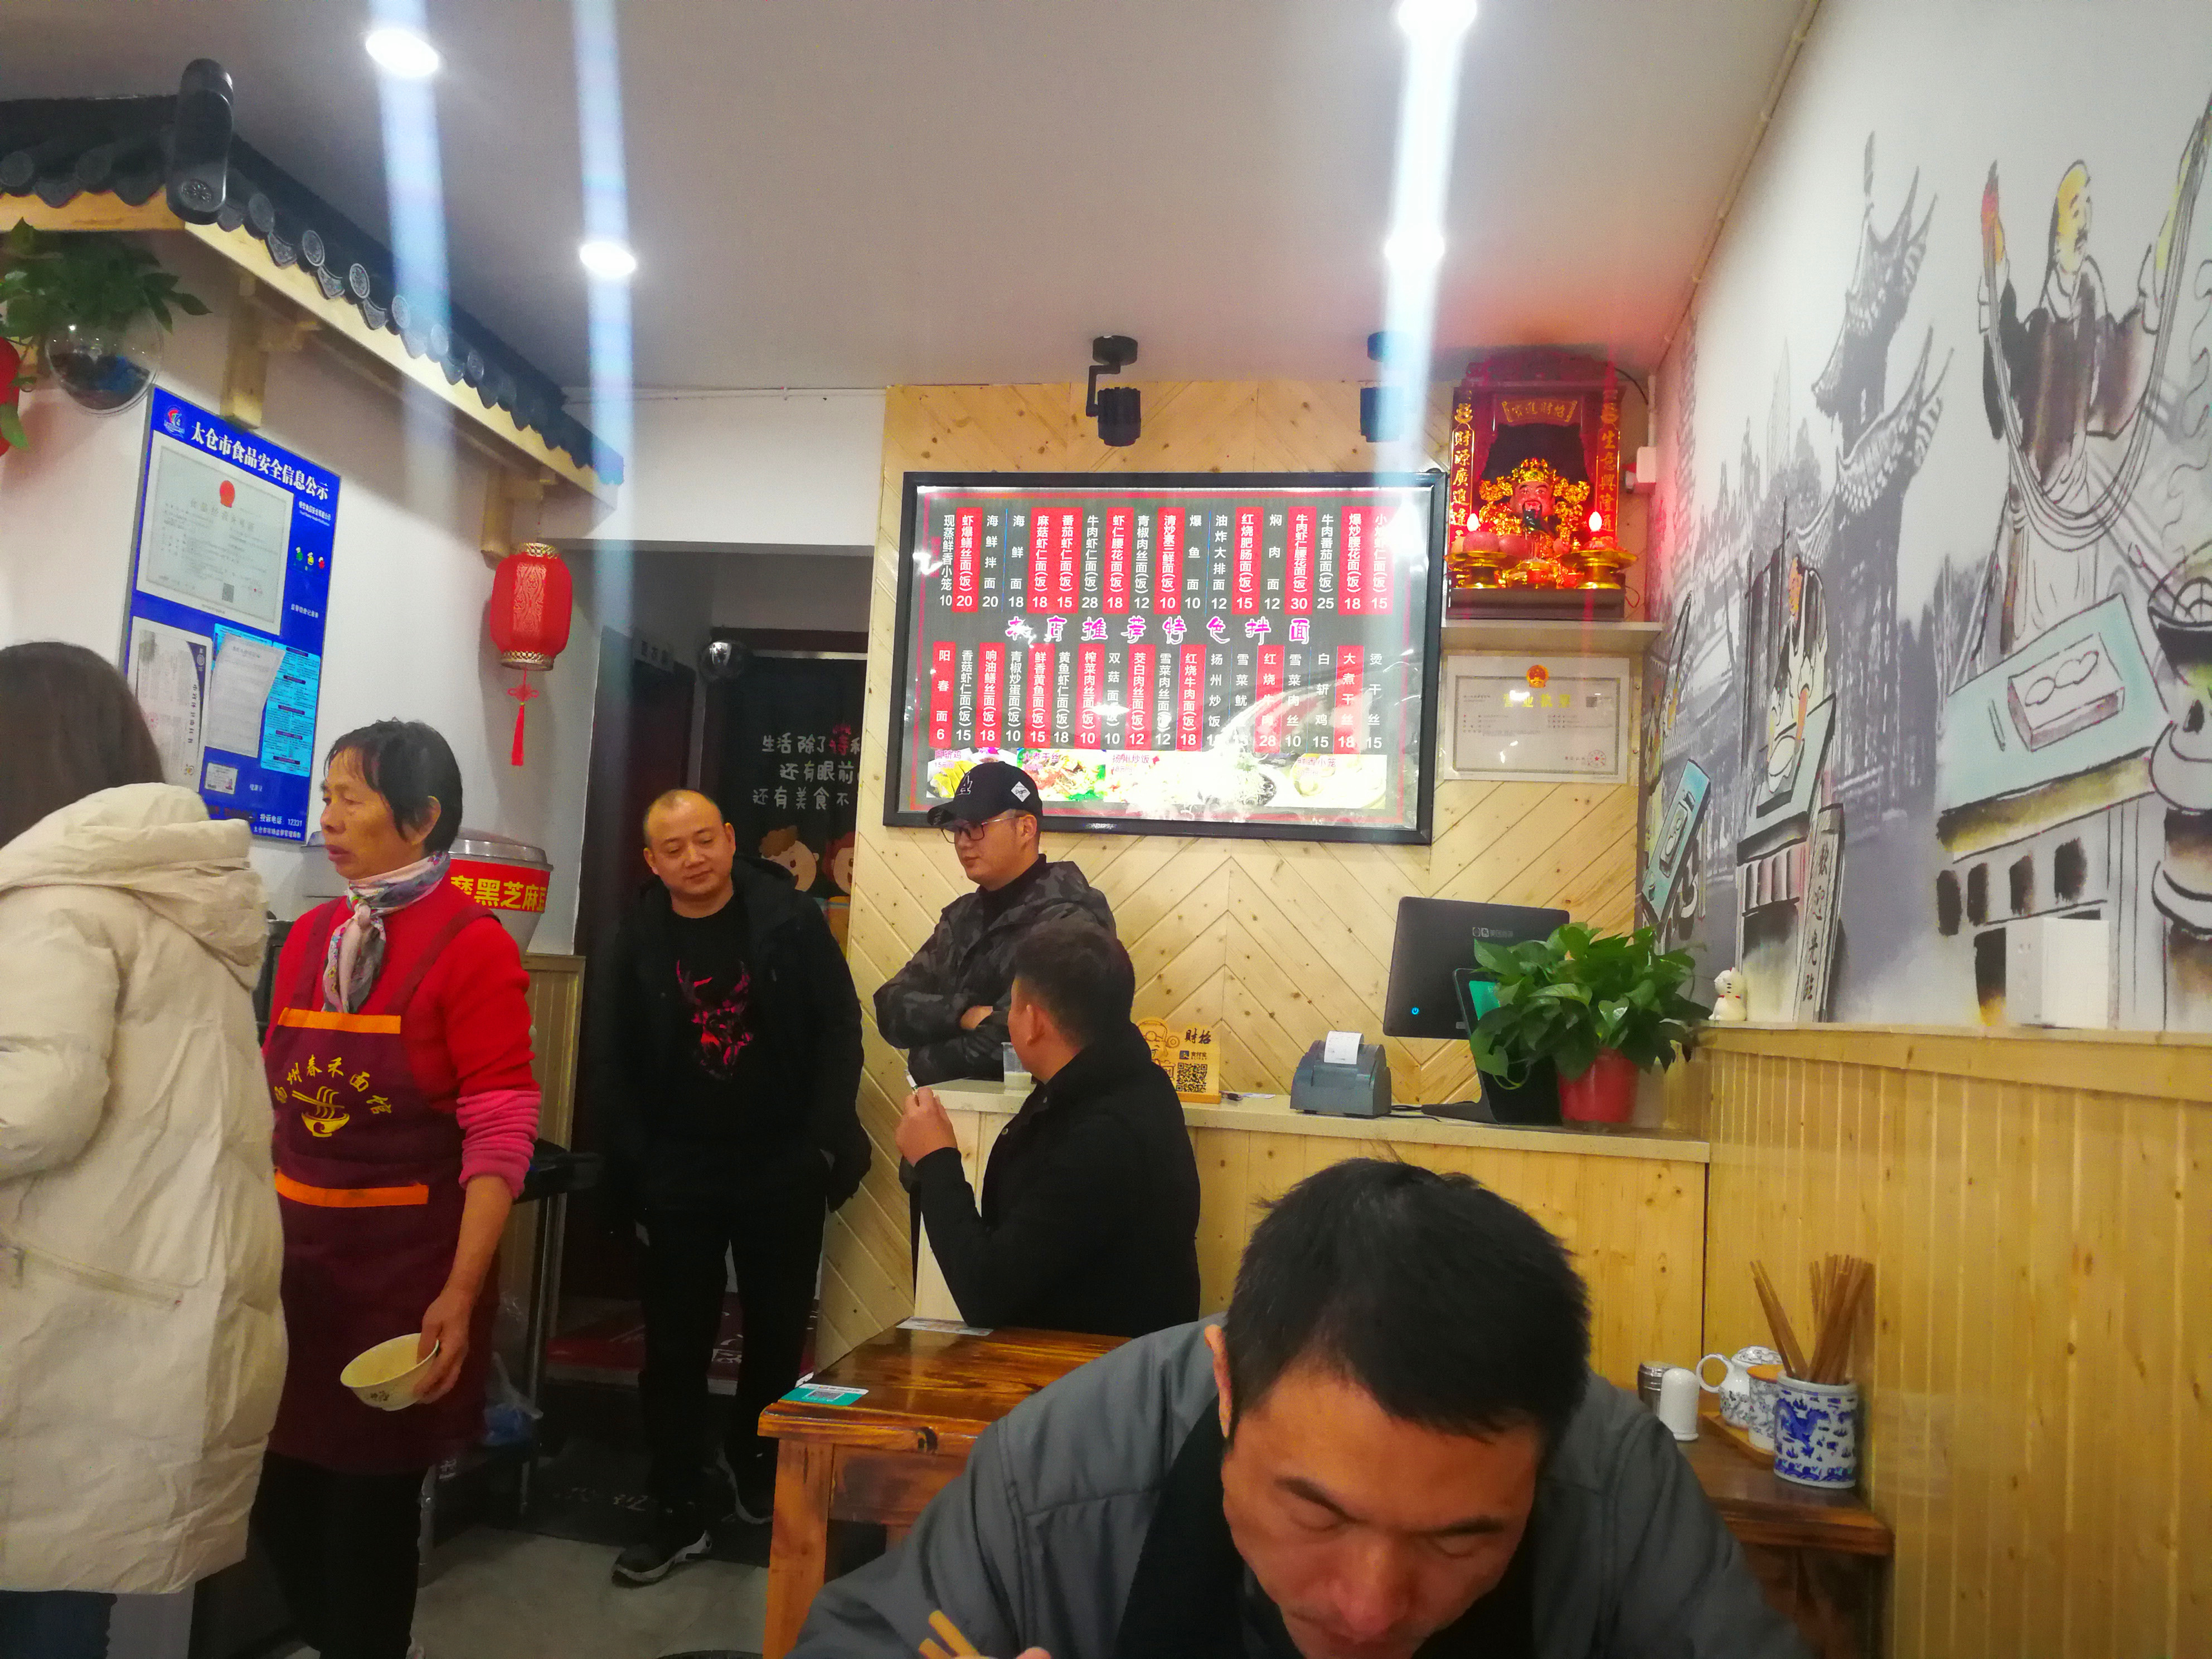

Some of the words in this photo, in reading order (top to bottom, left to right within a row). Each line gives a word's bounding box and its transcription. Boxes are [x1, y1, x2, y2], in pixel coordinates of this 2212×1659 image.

[191, 421, 328, 500] 太仓市食品安全信息公示
[941, 515, 955, 591] 现蒸鲜香小笼
[959, 515, 974, 591] 虾爆鳝丝面(饭)
[984, 515, 998, 589] 海鲜拌面
[1010, 515, 1025, 590] 海鲜面
[1034, 515, 1049, 591] 麻菇虾仁面(饭)
[1059, 515, 1074, 591] 番茄虾仁面(饭)
[1084, 515, 1099, 591] 牛肉虾仁面(饭)
[1110, 515, 1125, 592] 虾仁腰花面(饭)
[1135, 515, 1149, 593] 青椒肉丝面(饭)
[1161, 515, 1176, 592] 清炒素三鲜面(饭)
[1187, 515, 1202, 590] 爆鱼面
[1213, 515, 1228, 590] 油炸大排面
[1239, 514, 1254, 592] 红烧肥肠面(饭)
[1267, 514, 1282, 590] 焖肉面
[1293, 514, 1308, 592] 牛肉虾仁腰花面(饭)
[1319, 514, 1334, 592] 牛肉番茄面(饭)
[1347, 513, 1361, 592] 爆炒腰花面(饭)
[1373, 514, 1388, 592] 小虾仁面(饭)
[940, 595, 952, 606] 10
[956, 595, 973, 607] 20
[982, 596, 998, 607] 20
[1008, 596, 1023, 608] 18
[1032, 596, 1047, 608] 18
[1057, 597, 1073, 608] 15
[1081, 597, 1098, 608] 28
[1107, 597, 1123, 608] 18
[1134, 598, 1149, 608] 12
[1160, 598, 1176, 608] 10
[1185, 598, 1200, 608] 10
[1211, 598, 1226, 609] 12
[1236, 598, 1253, 608] 15
[1264, 598, 1280, 609] 12
[1291, 598, 1307, 609] 30
[1317, 598, 1334, 609] 25
[1345, 598, 1361, 609] 18
[1371, 598, 1388, 609] 15
[936, 650, 950, 721] 阳春面
[959, 650, 973, 726] 香菇虾仁面(饭)
[983, 651, 997, 727] 响油鳝丝面(饭)
[1008, 651, 1022, 727] 青椒炒蛋面(饭)
[1032, 652, 1046, 729] 鲜香黄鱼面(饭)
[1056, 652, 1071, 729] 黄鱼虾仁面(饭)
[1082, 651, 1097, 729] 榨菜肉丝面(饭)
[1107, 653, 1120, 726] 双菇面)
[1131, 652, 1146, 730] 茭白肉丝面(饭)
[1182, 653, 1197, 731] 红烧牛肉面(饭)
[1209, 653, 1223, 727] 扬州炒饭
[1234, 653, 1249, 726] 雪菜鱿
[1262, 653, 1277, 725] 红烧牛肉
[1287, 654, 1301, 726] 雪菜肉丝
[1315, 653, 1330, 726] 白斩鸡
[1341, 653, 1356, 725] 大煮干丝
[1367, 653, 1382, 725] 烫干丝
[937, 729, 944, 739] 6
[957, 730, 971, 740] 15
[980, 730, 995, 741] 18
[1006, 730, 1021, 741] 10
[1030, 731, 1045, 742] 15
[1054, 731, 1069, 743] 18
[1080, 733, 1095, 744] 10
[1105, 733, 1120, 744] 10
[1129, 734, 1144, 744] 12
[1156, 734, 1171, 745] 12
[1180, 734, 1196, 745] 18
[1259, 735, 1276, 746] 28
[1286, 736, 1301, 746] 10
[1313, 736, 1329, 747] 15
[1338, 736, 1355, 748] 18
[1366, 737, 1382, 748] 15
[780, 760, 860, 784] 还有眼前
[753, 785, 850, 809] 还有美食不
